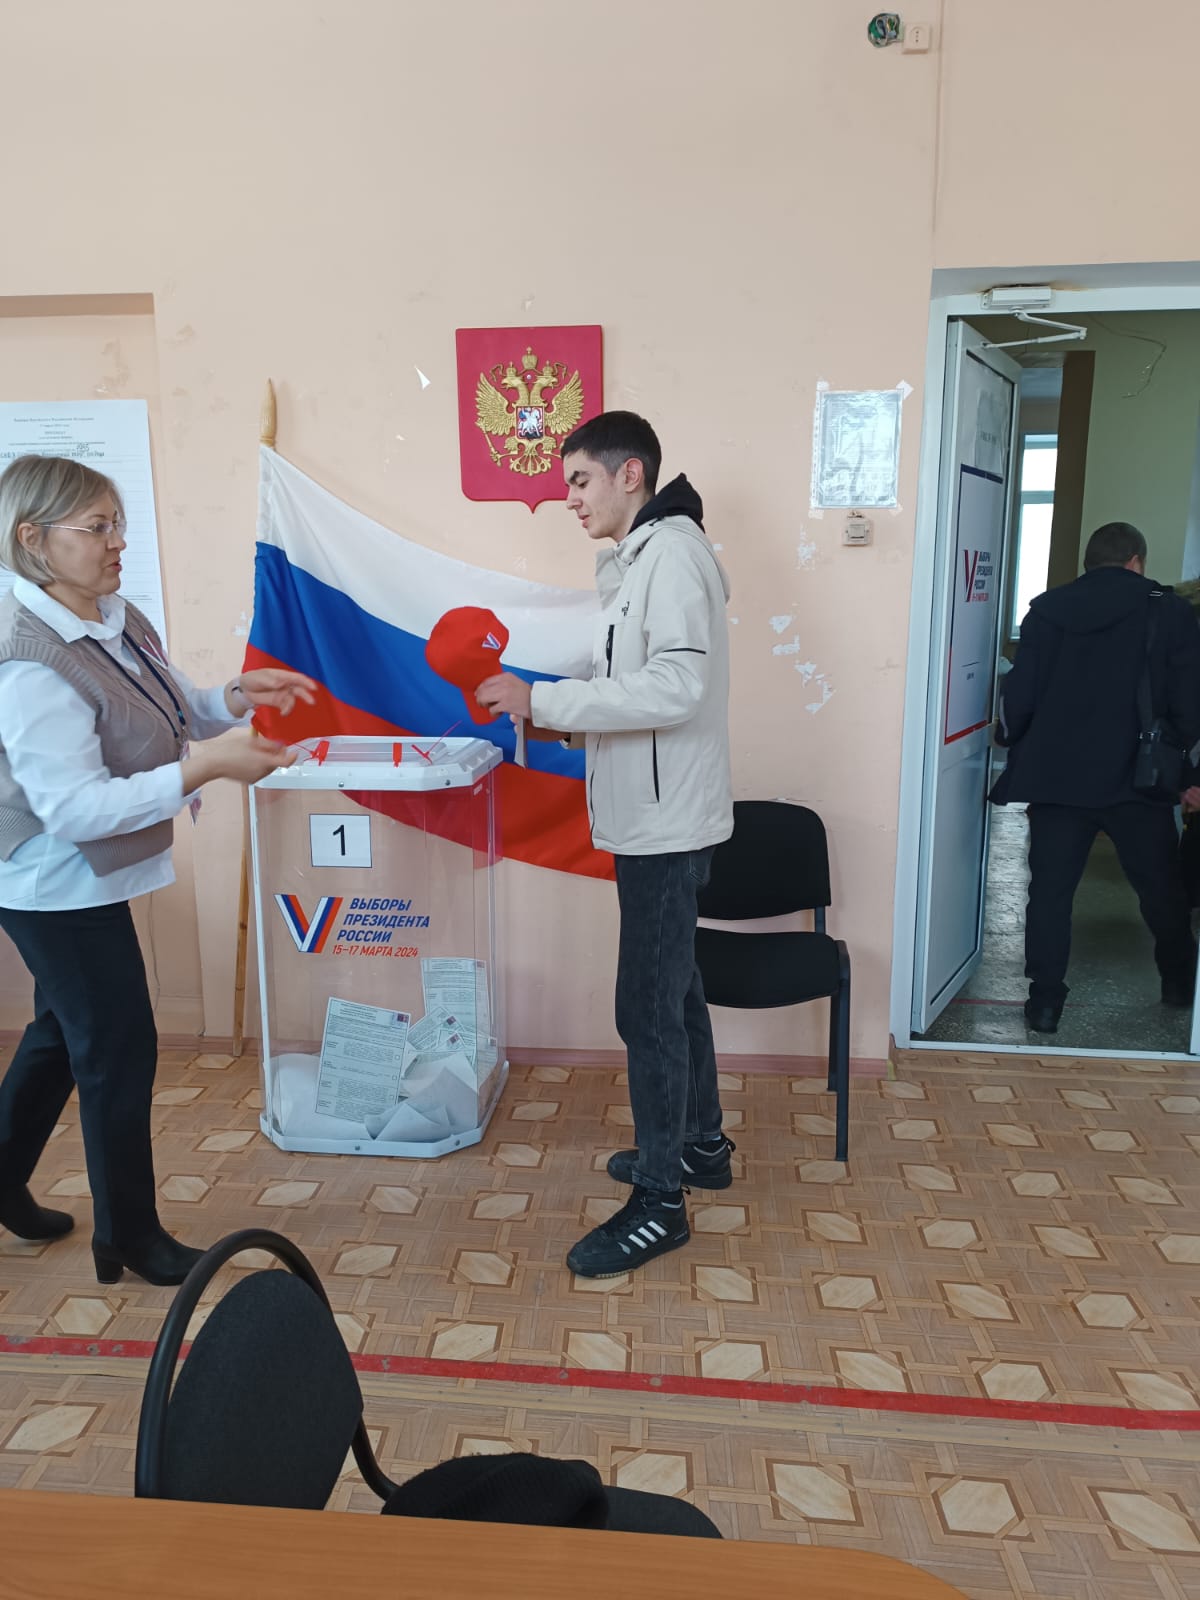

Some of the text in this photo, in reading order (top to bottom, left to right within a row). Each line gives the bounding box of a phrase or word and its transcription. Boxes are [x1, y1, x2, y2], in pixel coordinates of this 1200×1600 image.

[332, 824, 346, 856] 1
[350, 897, 412, 911] ВЫБОРЫ
[343, 913, 430, 929] ПРЕЗИДЕНТА
[337, 930, 393, 943] РОССИИ
[361, 946, 393, 958] МАРТА
[394, 947, 419, 958] 2024
